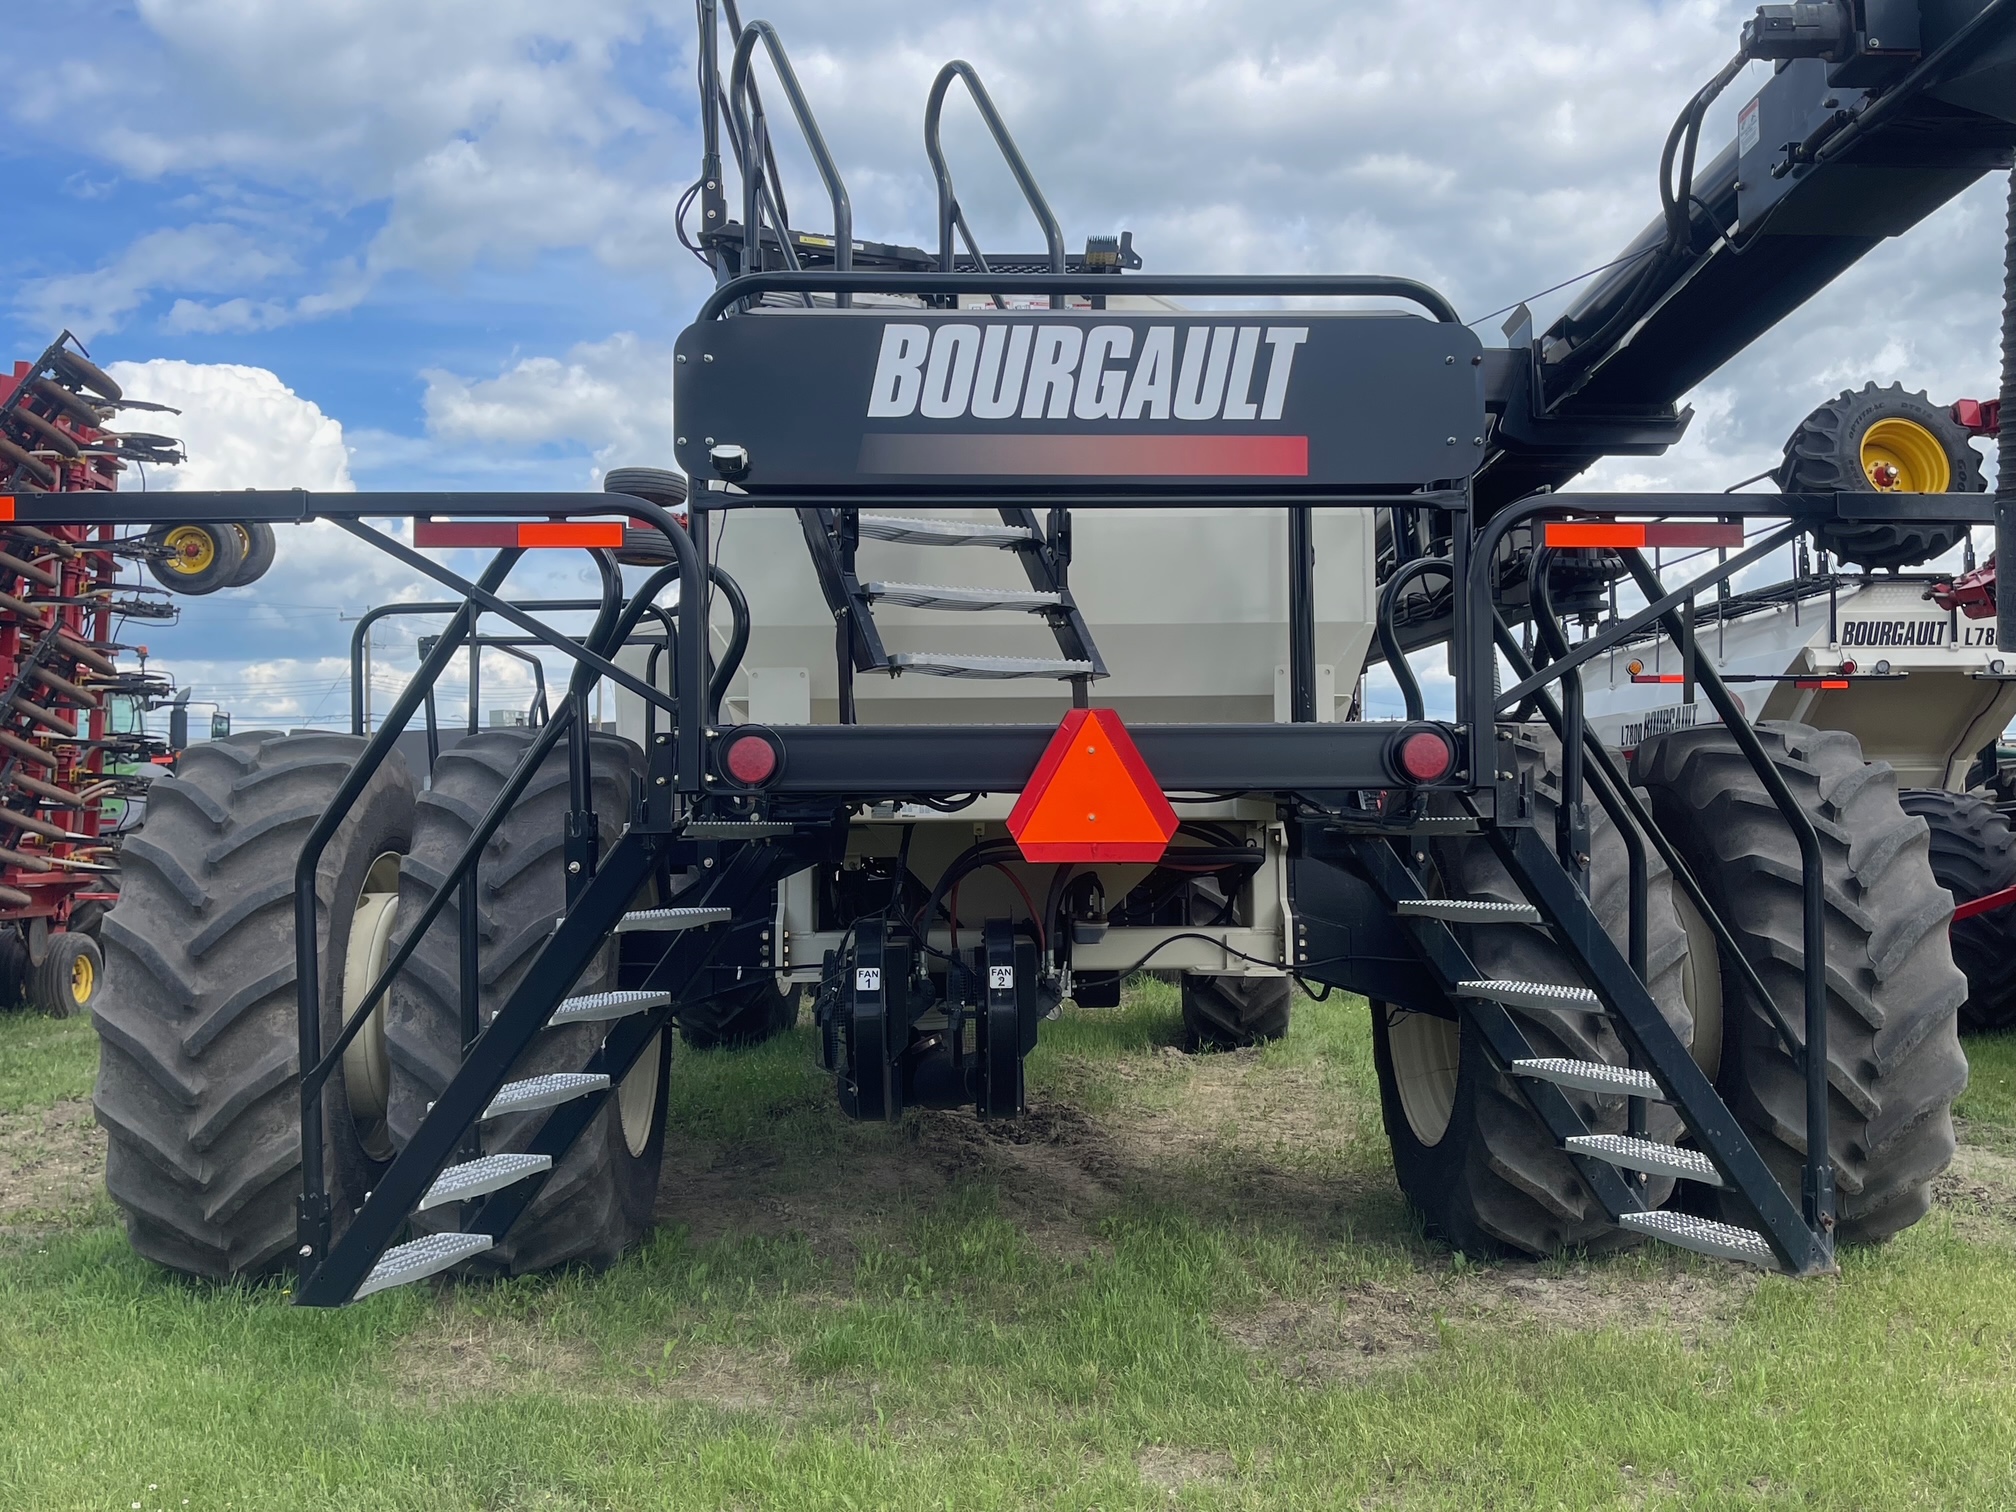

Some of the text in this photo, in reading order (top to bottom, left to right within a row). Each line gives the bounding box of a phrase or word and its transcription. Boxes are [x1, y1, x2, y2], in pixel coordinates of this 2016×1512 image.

[867, 324, 1309, 420] BOURGAULT
[1841, 621, 1998, 646] BOURGAULT L78
[1621, 704, 1698, 746] L7800 BOURGAULT
[858, 970, 879, 978] FAN
[991, 968, 1012, 977] FAN
[865, 978, 871, 988] 1
[997, 977, 1006, 987] 2
